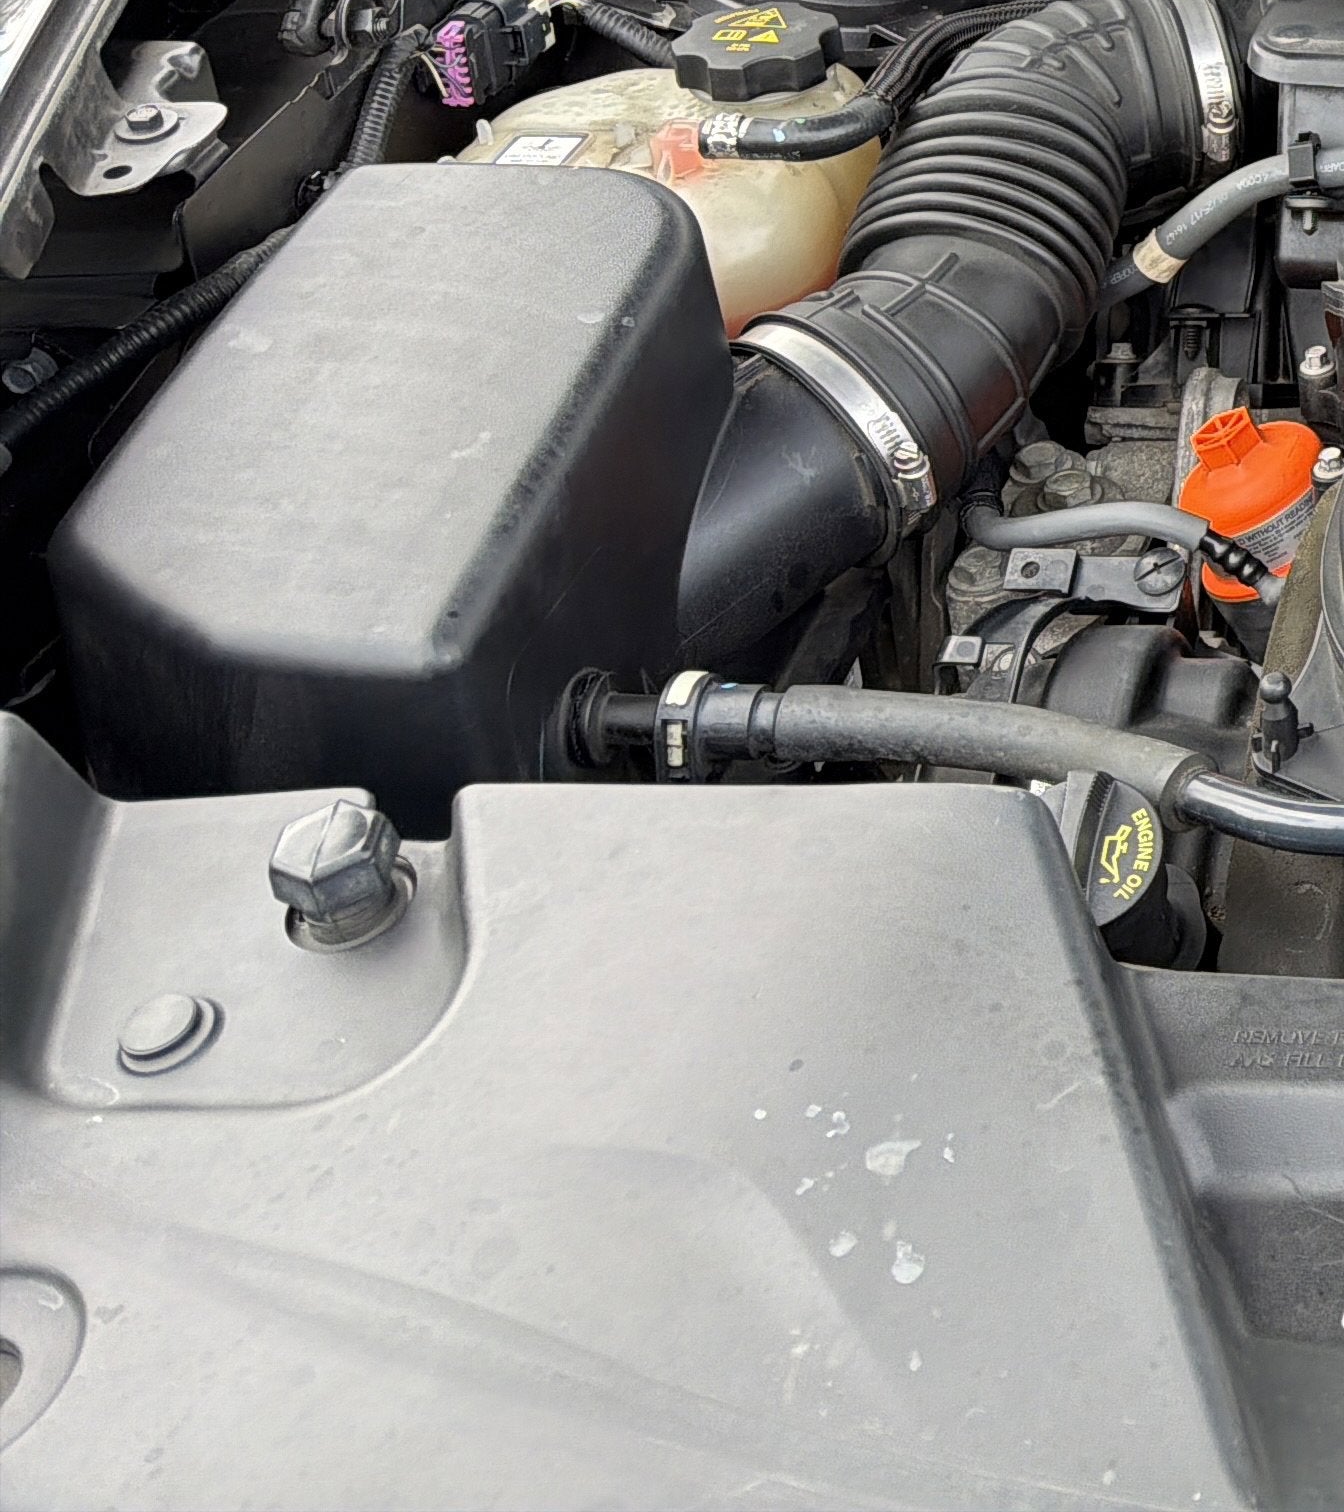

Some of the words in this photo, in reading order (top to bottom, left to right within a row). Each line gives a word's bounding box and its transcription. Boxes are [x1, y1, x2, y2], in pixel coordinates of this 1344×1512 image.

[1131, 808, 1154, 872] ENGINE
[1113, 874, 1143, 900] OIL
[1233, 1029, 1324, 1046] REMOVE
[1284, 1052, 1328, 1069] FILL
